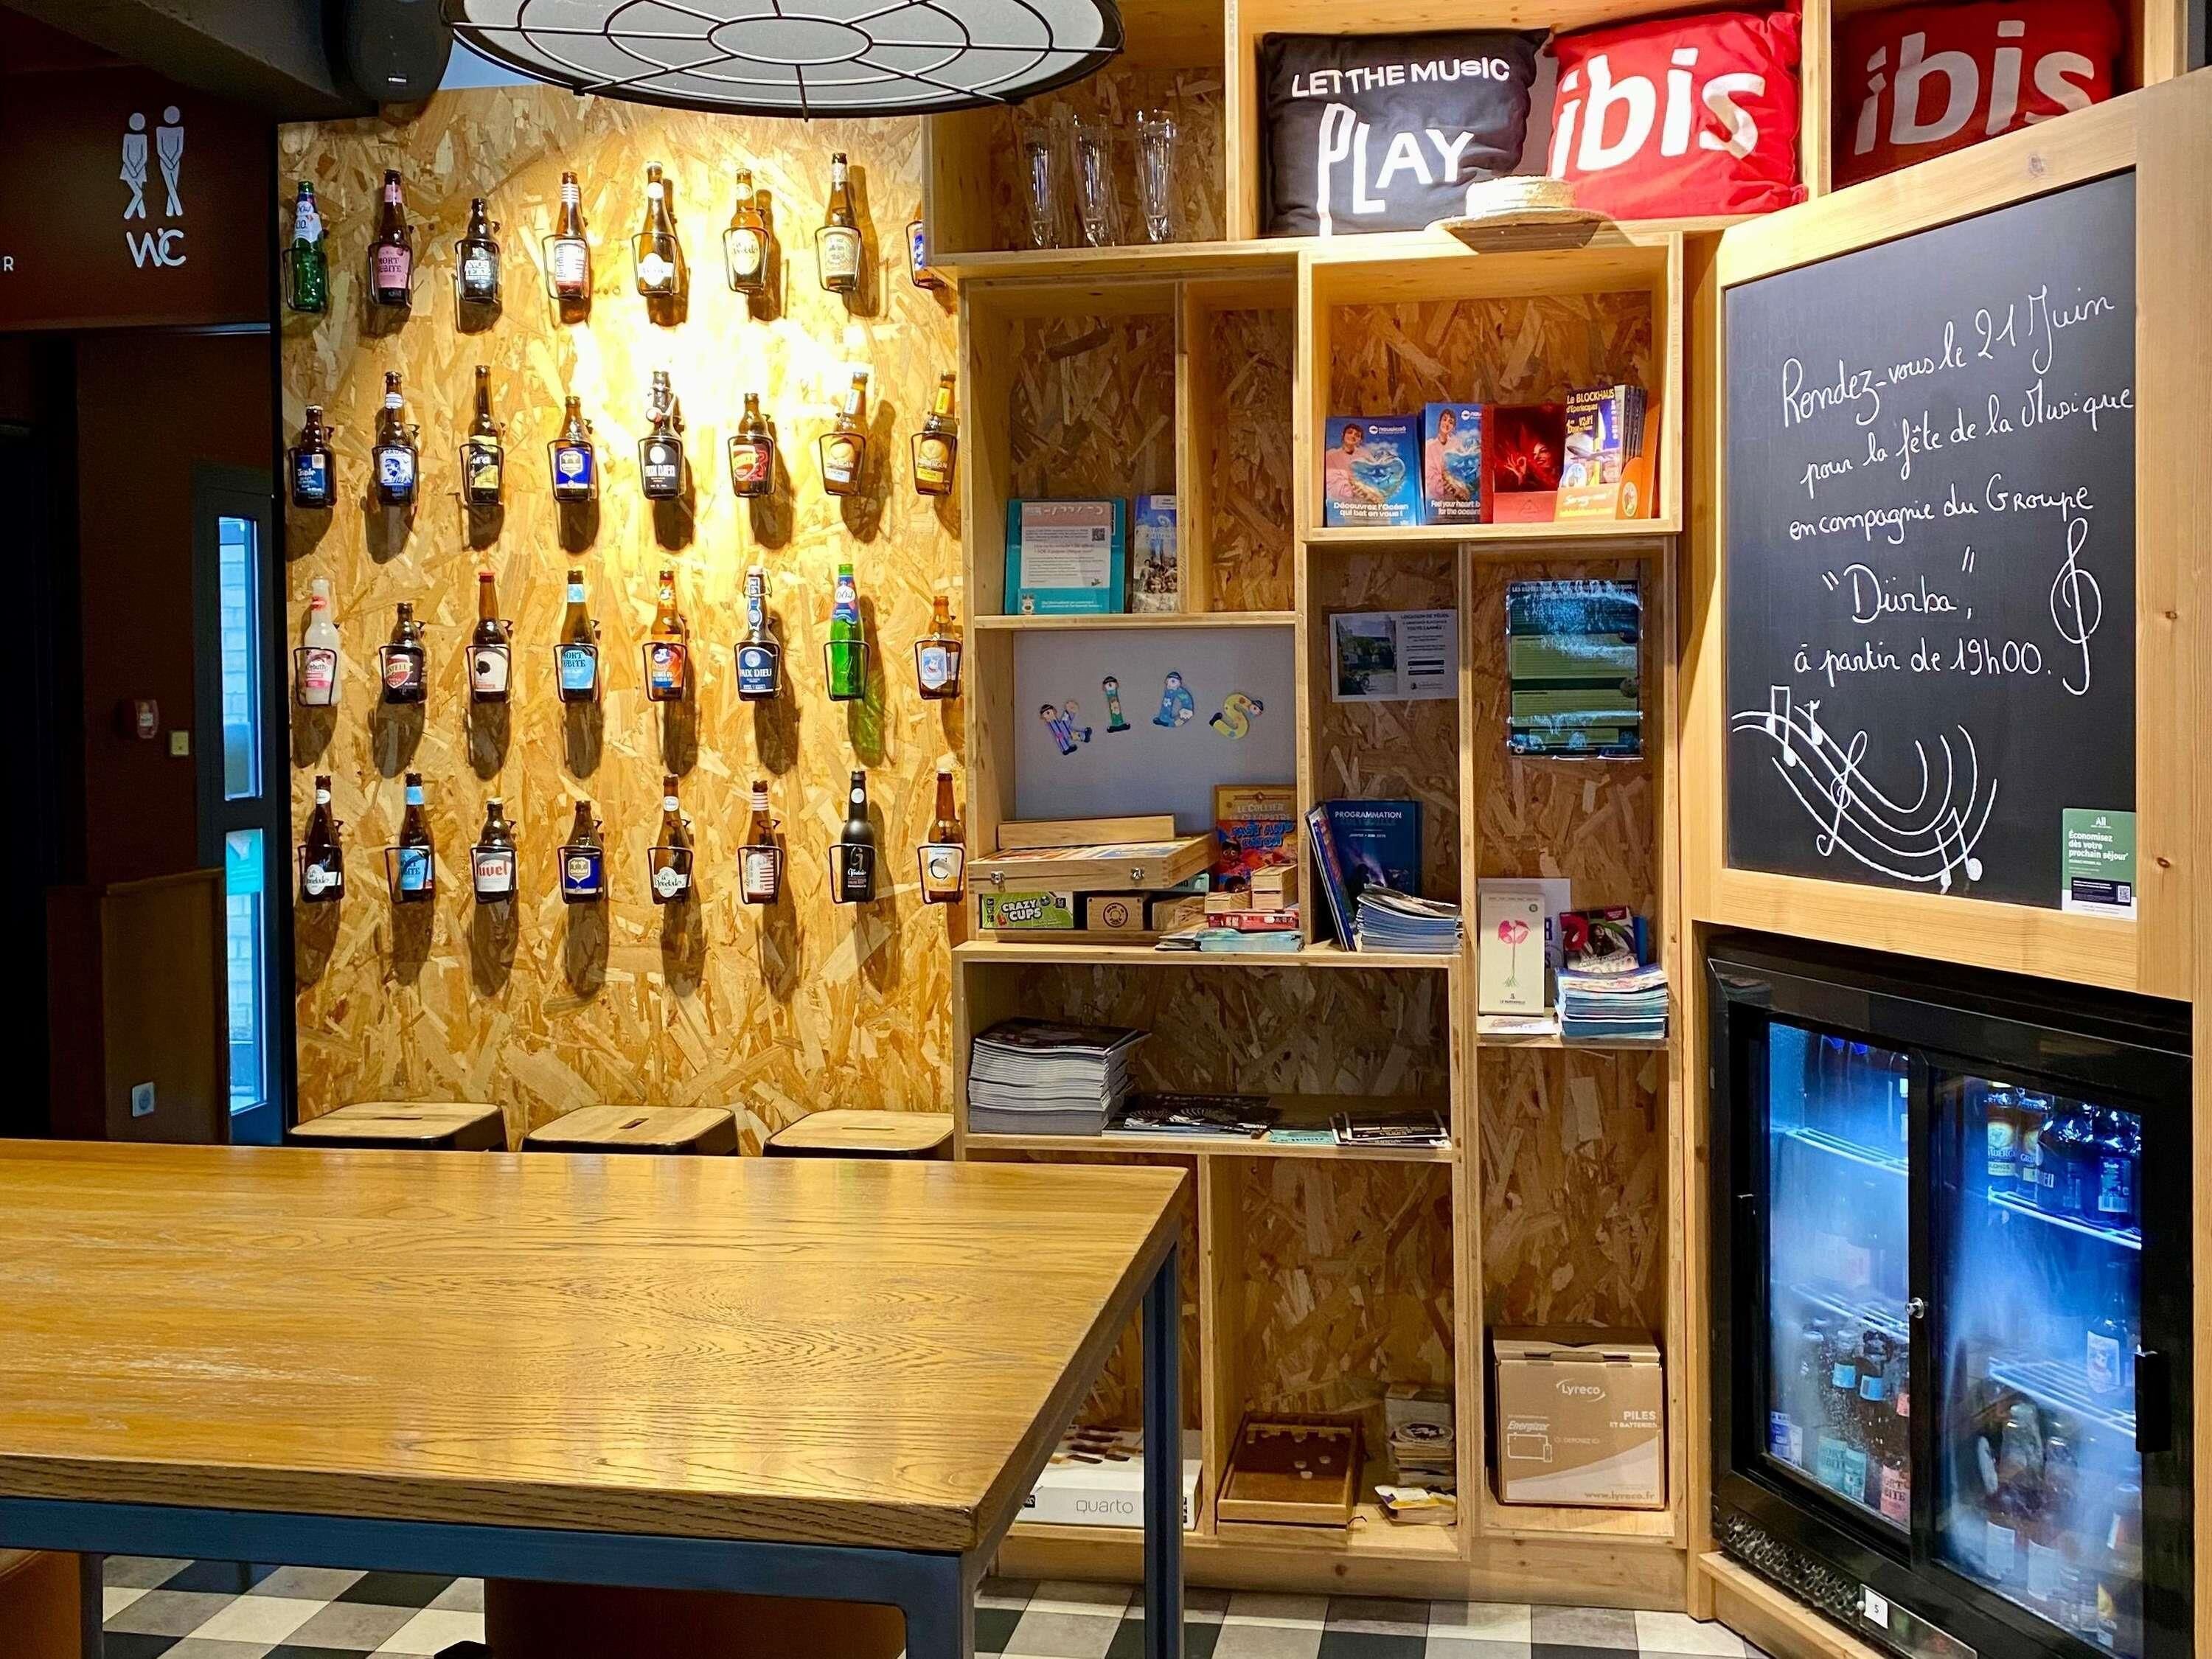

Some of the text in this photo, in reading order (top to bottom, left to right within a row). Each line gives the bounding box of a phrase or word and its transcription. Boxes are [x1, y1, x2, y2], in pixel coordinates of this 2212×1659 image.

[1292, 57, 1510, 97] LET THE MUSIC
[1854, 20, 2095, 156] ibis
[1550, 47, 1766, 179] ibis
[1317, 102, 1474, 237] PLAY
[126, 228, 187, 268] WC
[4, 256, 14, 271] R
[1783, 285, 2115, 428] Rendez-vous le 21 Juin
[1576, 389, 1615, 403] BLOCKHAUS
[1800, 378, 2134, 499] pour la fête de la Musique
[1790, 521, 1816, 540] en
[1818, 500, 1935, 544] compagnie
[1944, 482, 1979, 517] du
[1819, 641, 1900, 687] partir
[1911, 637, 1941, 672] de
[754, 668, 773, 677] DIEU
[1335, 811, 1402, 819] PROGRAMMATION
[2068, 829, 2114, 842] Économisez
[2068, 840, 2082, 849] dès
[2068, 849, 2101, 860] prochain
[479, 865, 509, 876] uvel
[1002, 900, 1037, 912] CRAZY
[1009, 908, 1042, 921] CUPS
[1562, 1383, 1600, 1396] Lyreco
[1624, 1411, 1656, 1420] PILES
